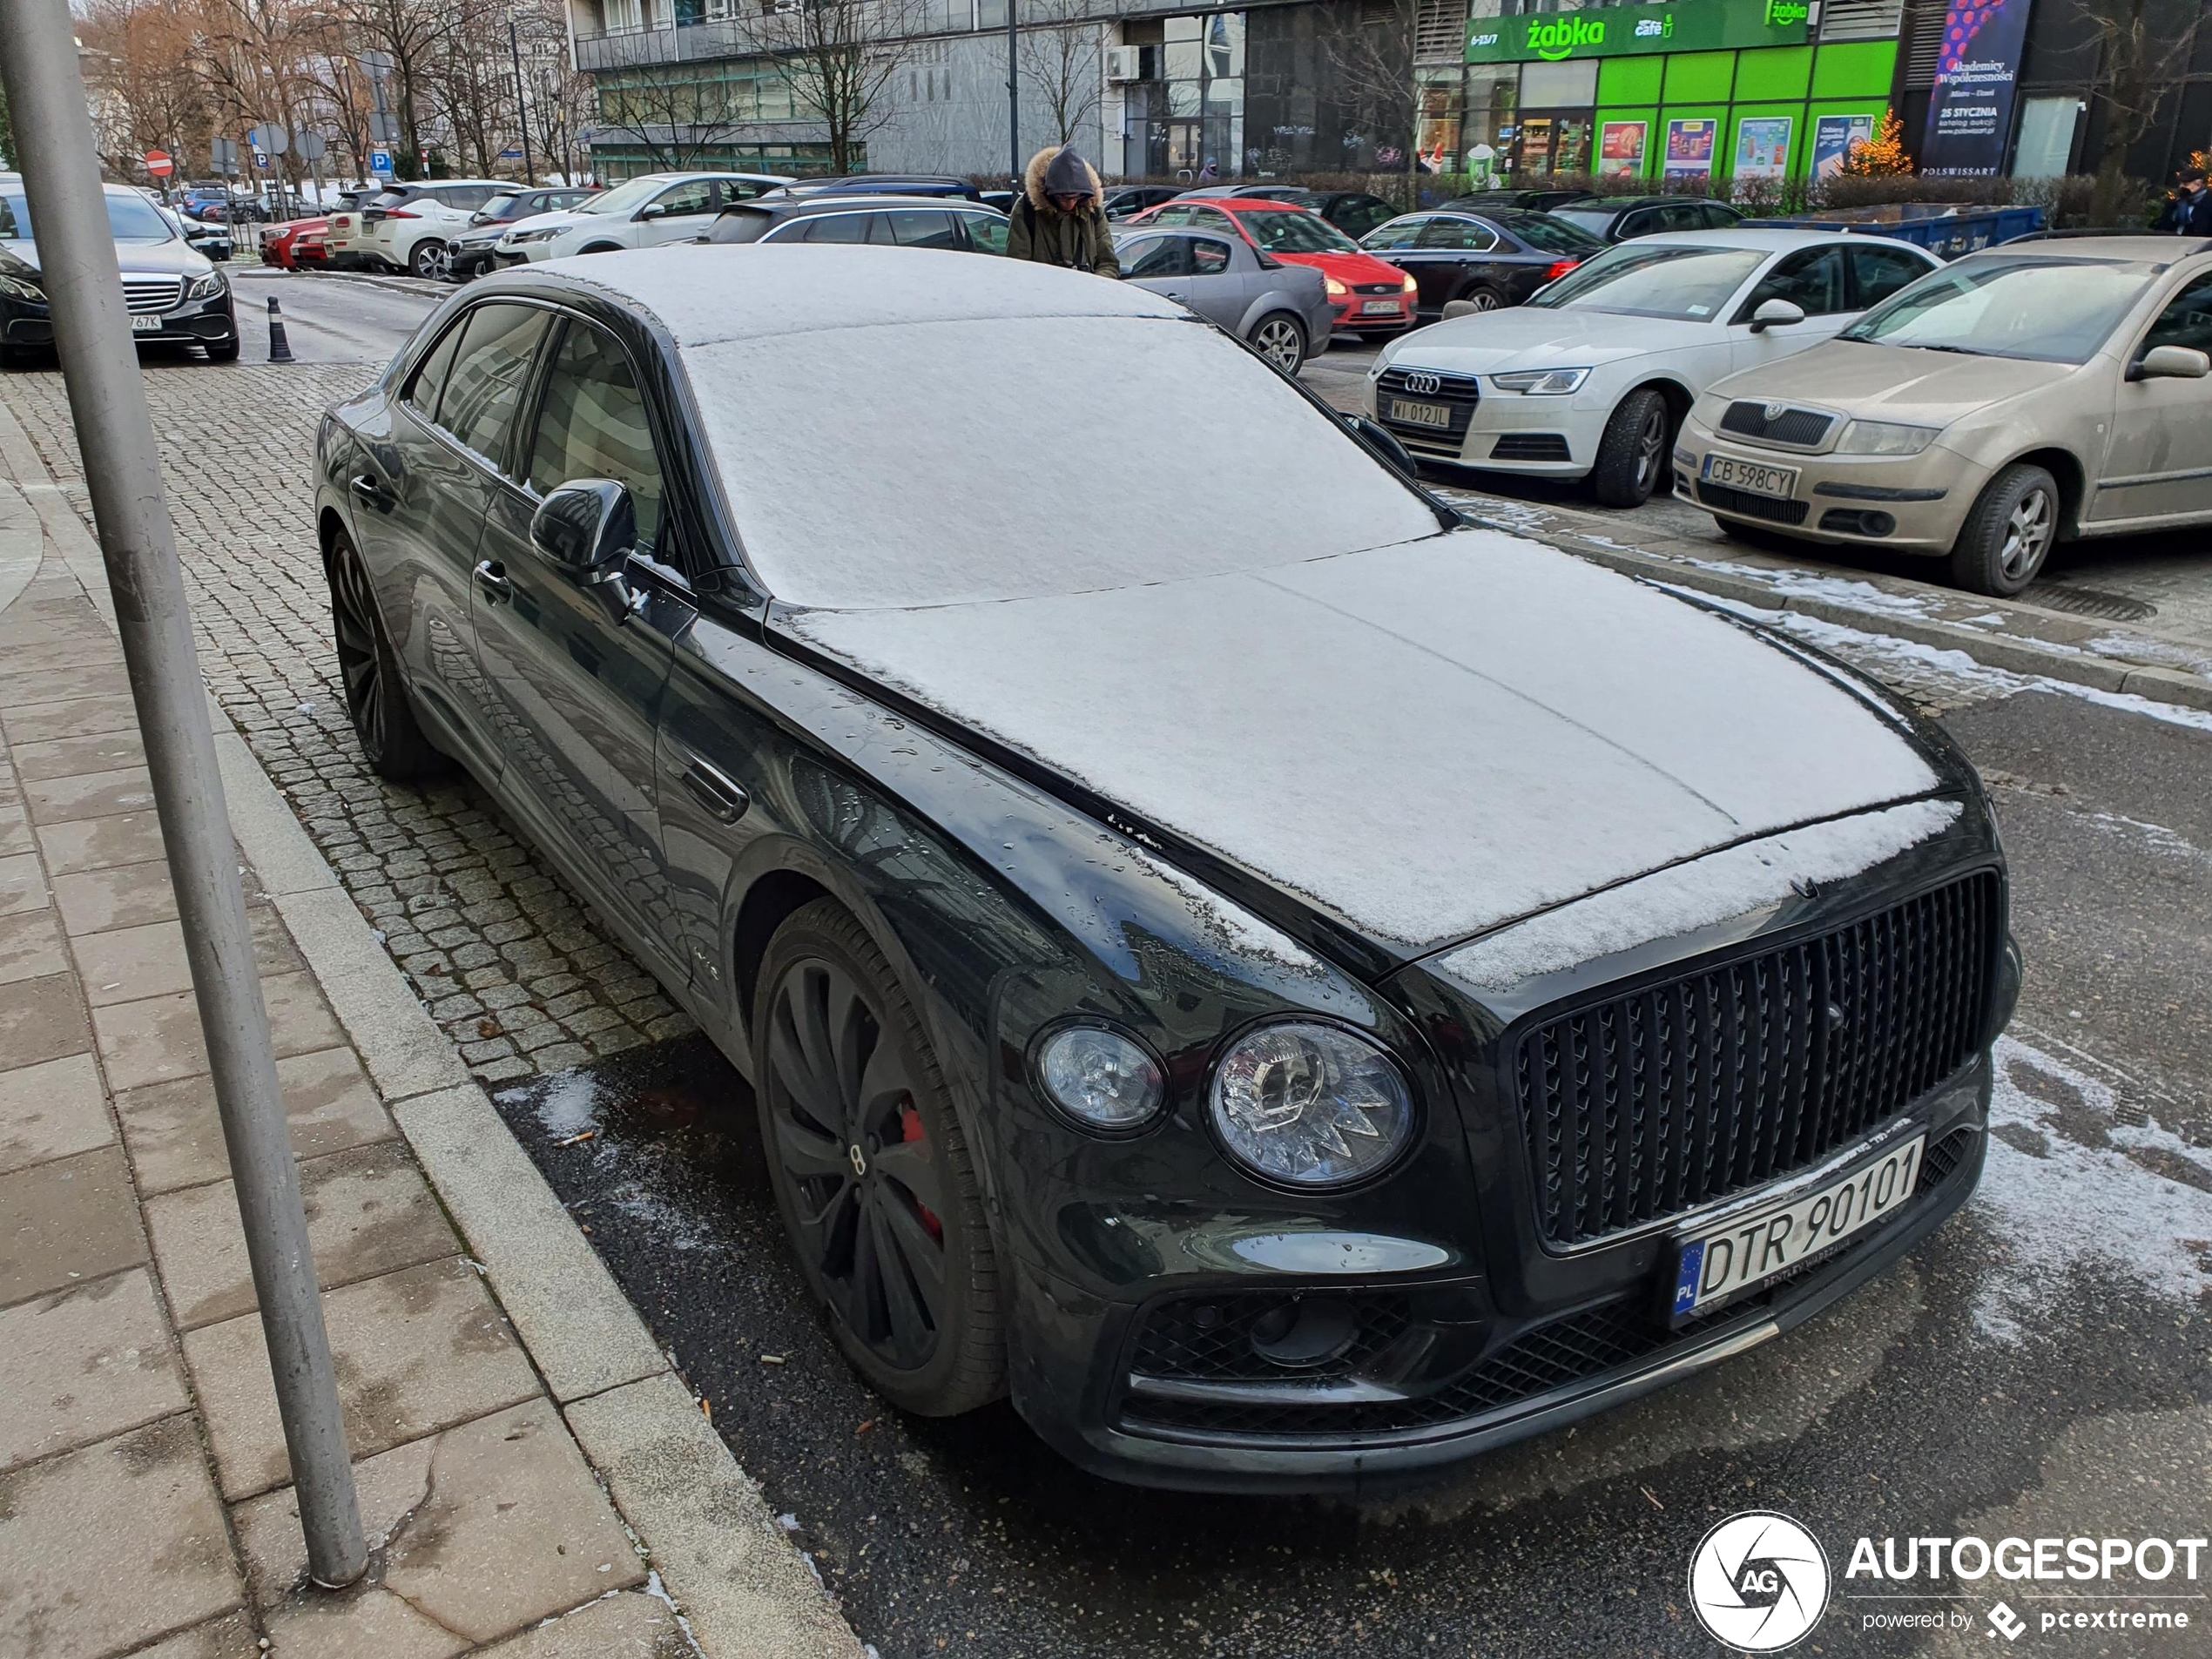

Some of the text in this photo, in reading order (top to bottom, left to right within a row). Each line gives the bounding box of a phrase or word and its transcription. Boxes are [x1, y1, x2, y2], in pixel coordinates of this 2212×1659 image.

[1771, 1, 1807, 18] żabka
[1527, 17, 1606, 49] żabka
[1950, 60, 2005, 72] Akademicy
[1939, 71, 2014, 85] Współczesności
[1940, 107, 1998, 118] 25 STYCZNIA
[374, 155, 385, 168] P
[1921, 167, 1997, 176] POLSWISSART
[1410, 404, 1446, 425] 012JL
[1712, 460, 1788, 493] CB 598CY
[1700, 1143, 1918, 1298] DTR 90101
[1676, 1281, 1695, 1303] PL
